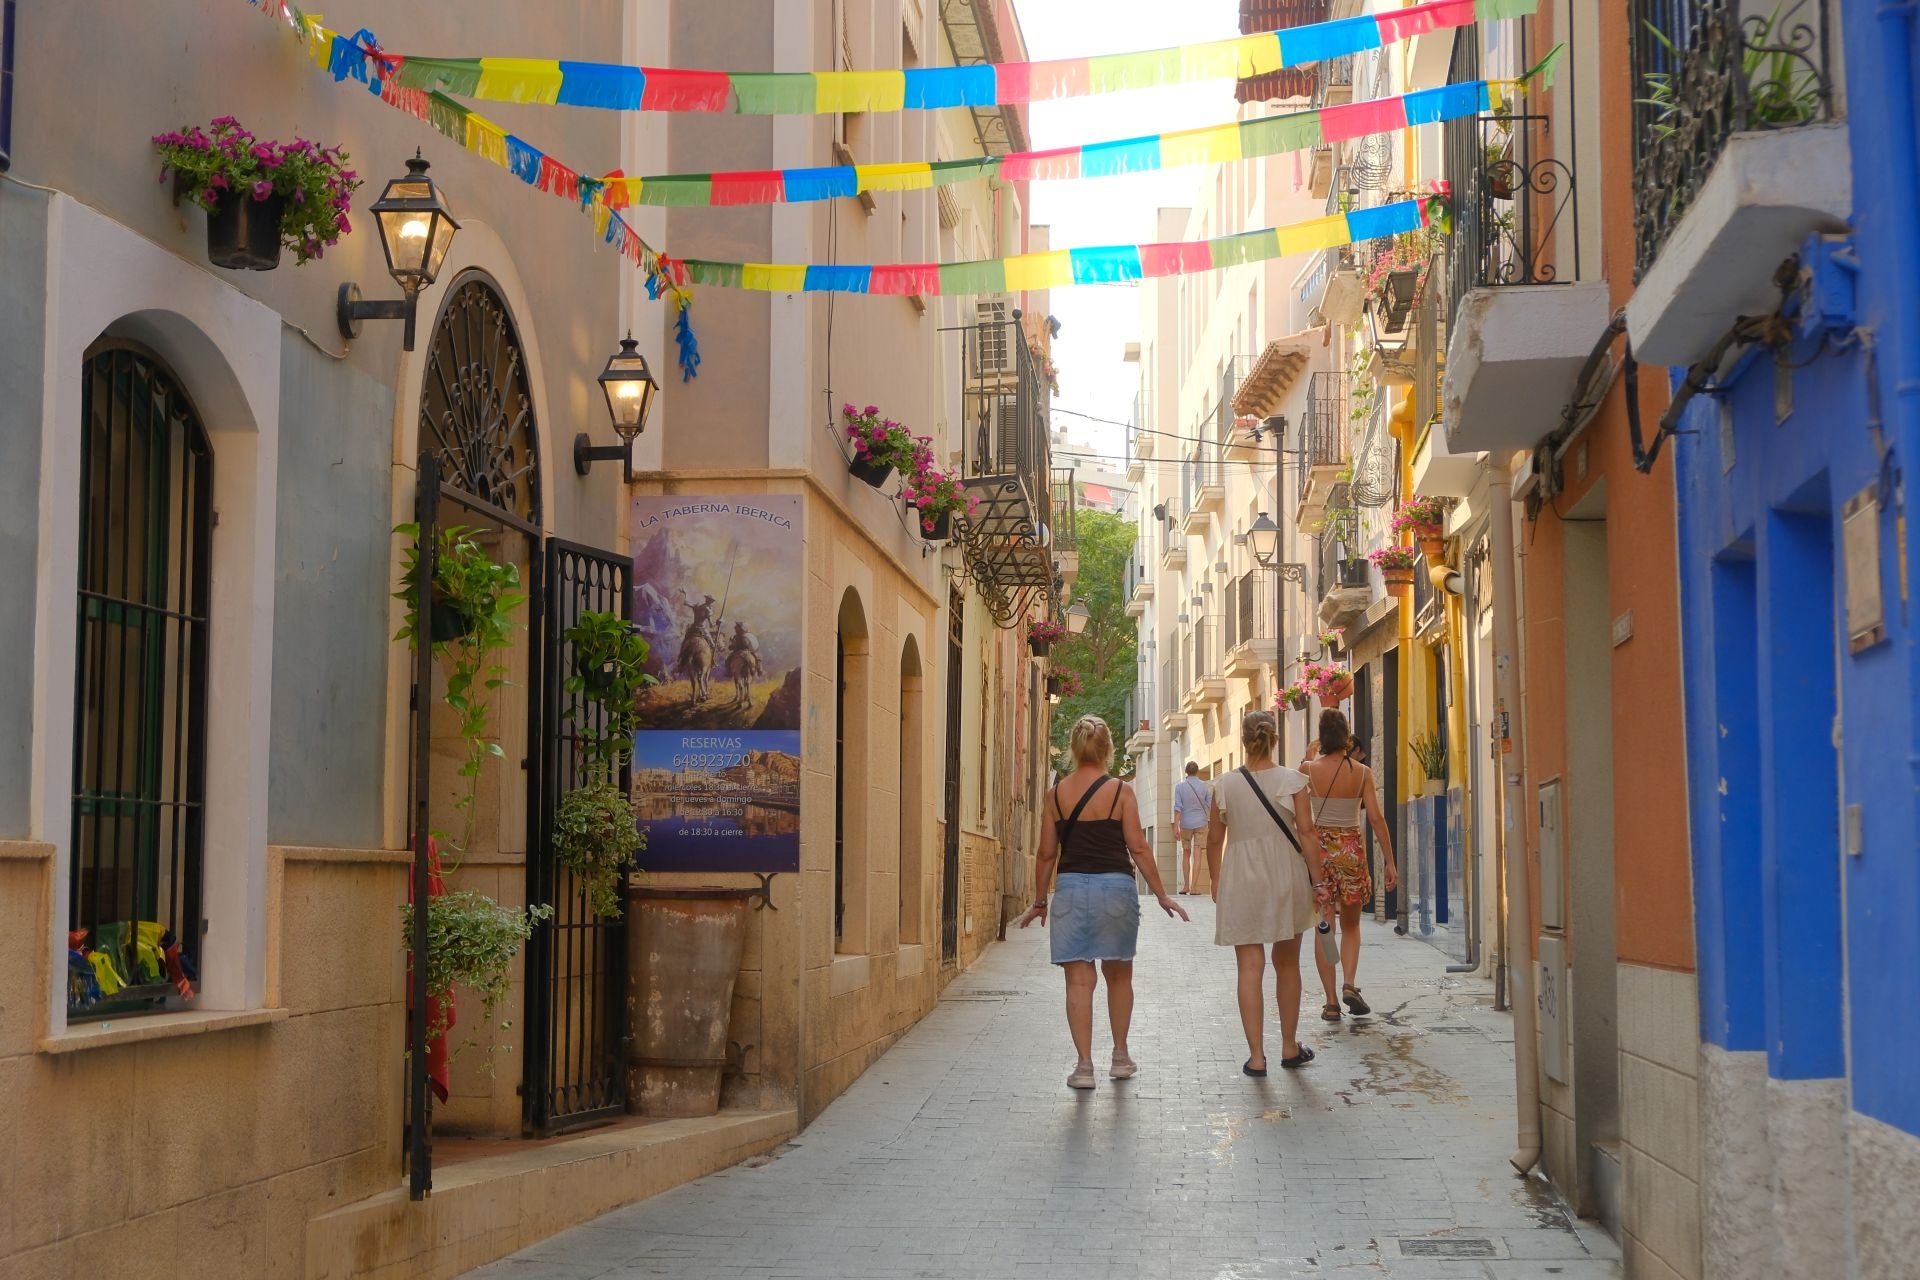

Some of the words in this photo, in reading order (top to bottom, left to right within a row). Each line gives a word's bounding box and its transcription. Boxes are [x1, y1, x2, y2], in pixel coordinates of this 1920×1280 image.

[640, 515, 659, 528] LA
[662, 504, 730, 519] TABERNA
[735, 505, 792, 529] IBERICA
[682, 737, 742, 749] RESERVAS
[673, 753, 751, 767] 648923720
[716, 795, 752, 805] domingo
[678, 828, 689, 836] de
[691, 828, 713, 836] 18:30
[721, 828, 744, 836] cierre
